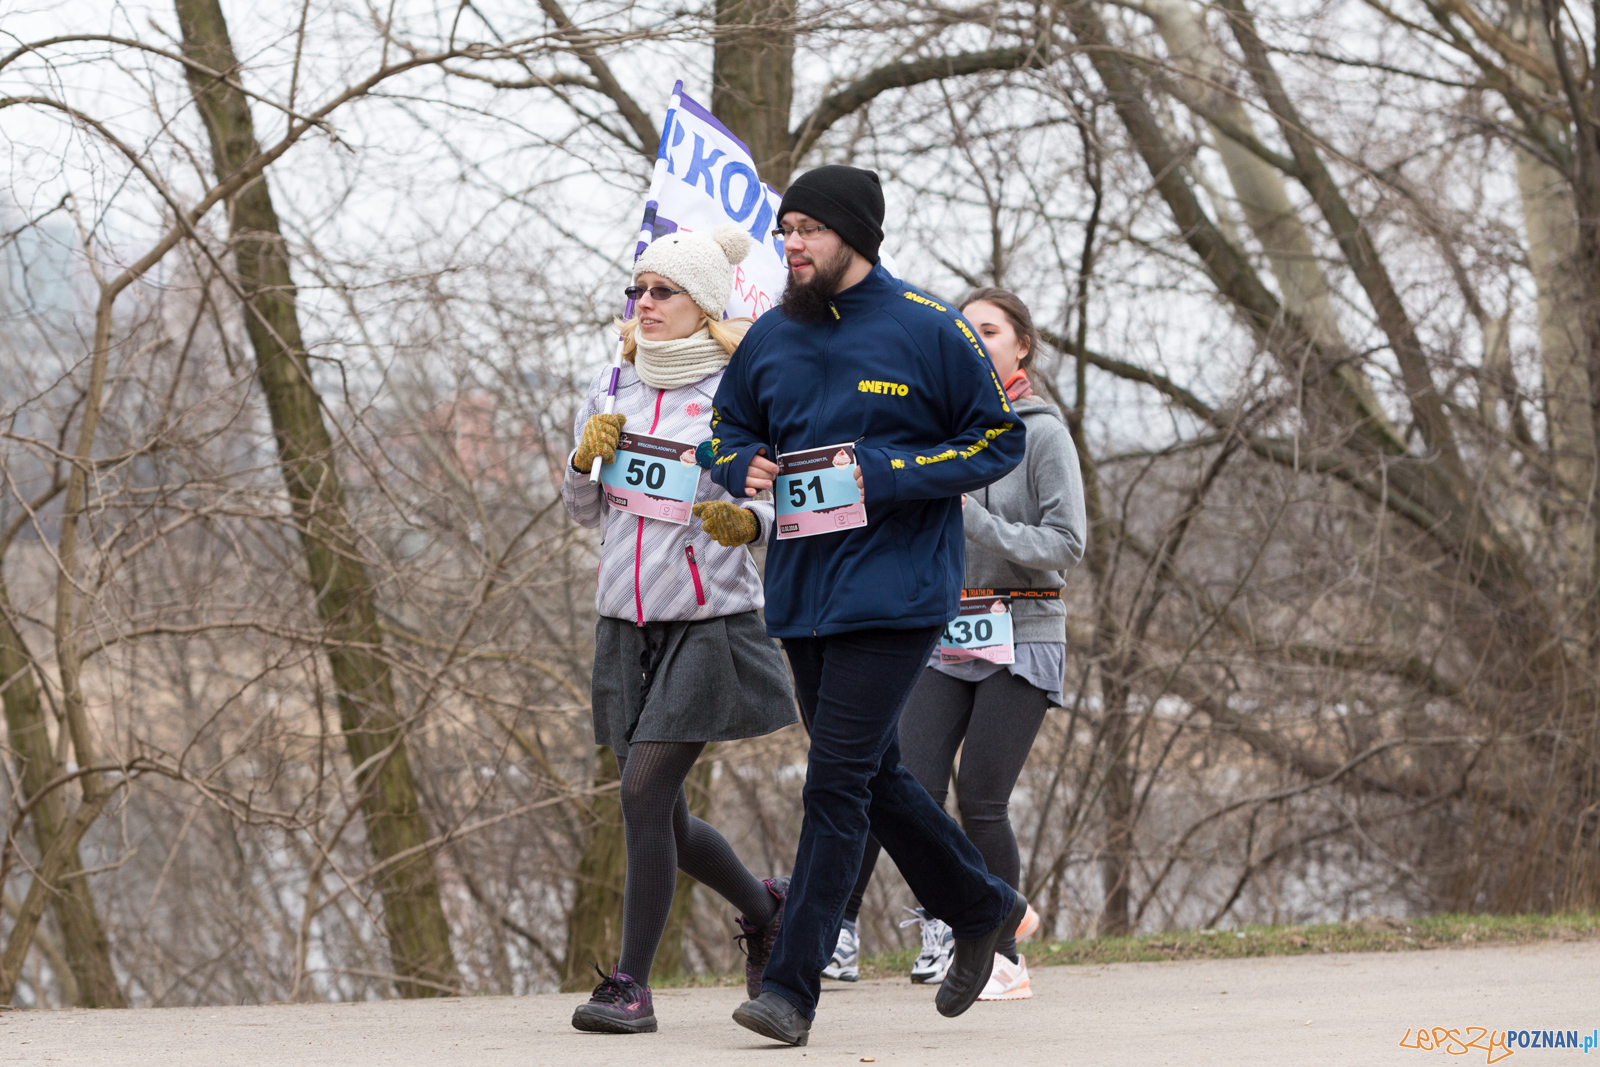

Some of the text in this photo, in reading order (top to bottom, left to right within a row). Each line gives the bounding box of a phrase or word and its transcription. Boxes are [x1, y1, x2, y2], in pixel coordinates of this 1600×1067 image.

[904, 291, 947, 311] NETTO
[860, 380, 909, 396] NETTO
[625, 458, 666, 490] 50
[789, 475, 825, 508] 51
[968, 589, 994, 597] TRIATHLON
